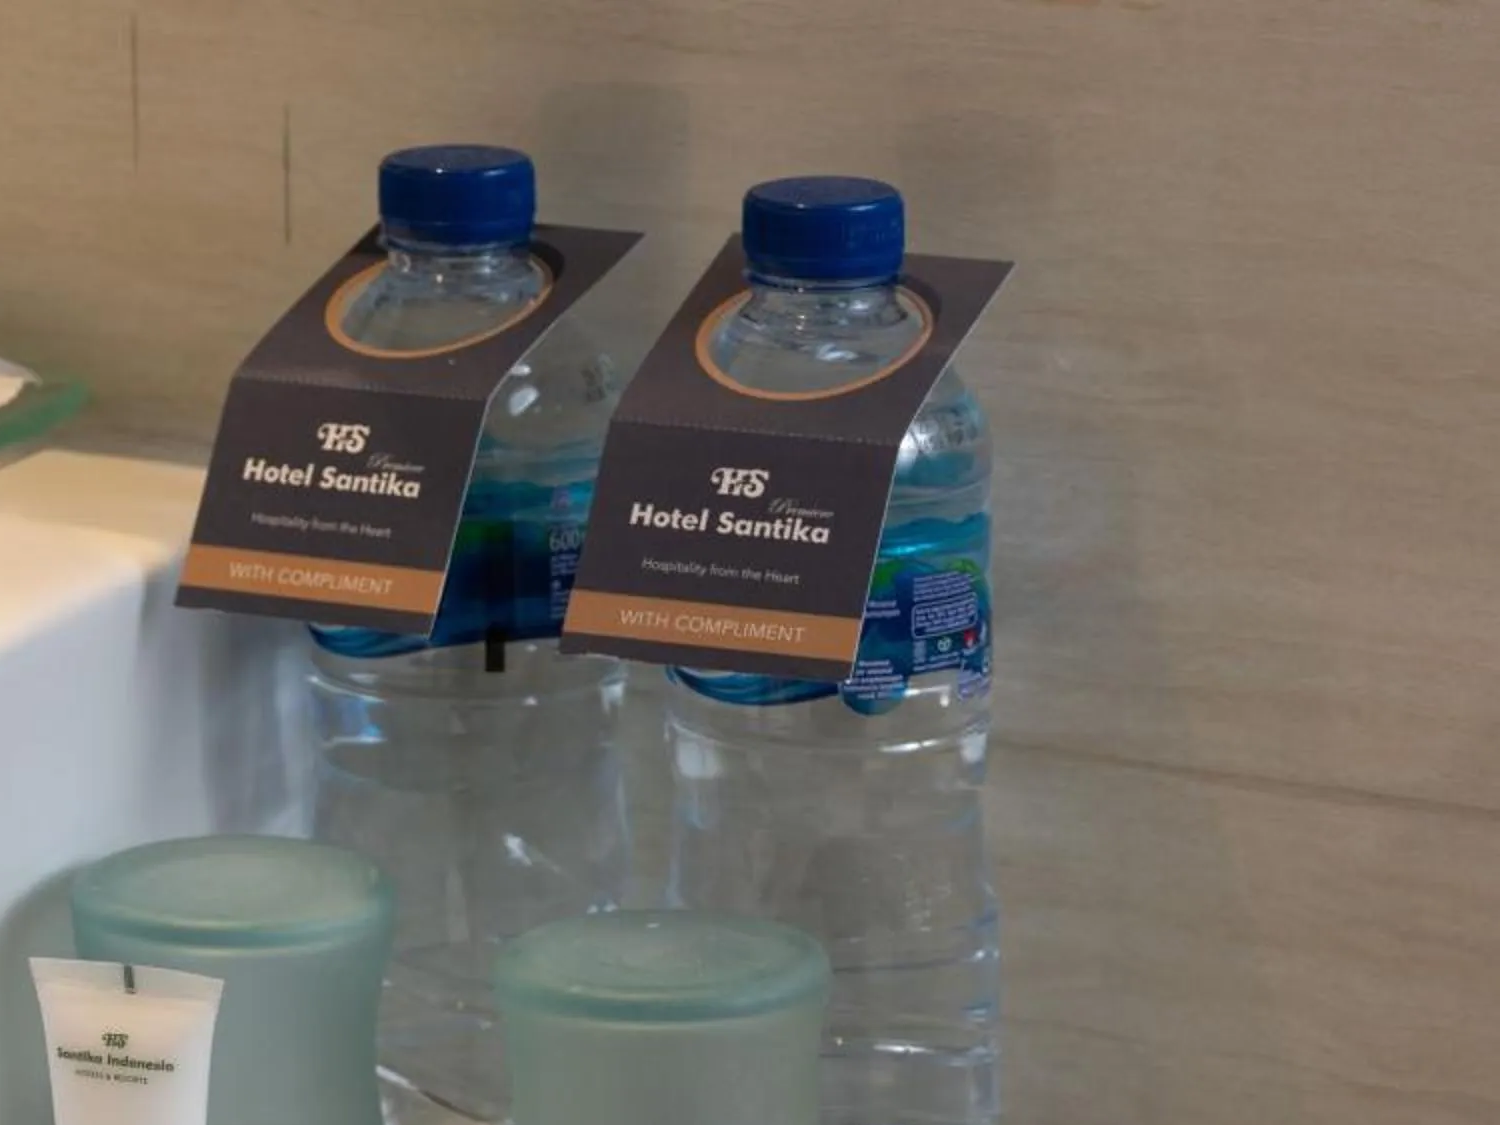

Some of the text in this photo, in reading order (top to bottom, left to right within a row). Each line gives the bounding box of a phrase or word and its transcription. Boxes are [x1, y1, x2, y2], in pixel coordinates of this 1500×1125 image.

[243, 457, 421, 499] Hotel Santika
[251, 511, 393, 540] Hospitality from the Heart
[628, 502, 831, 545] Hotel Santika
[227, 561, 394, 595] WITH COMPLIMENT
[641, 557, 801, 586] Hospitality from the Heart
[618, 609, 807, 643] WITH COMPLIMENT
[56, 1046, 176, 1073] Santika Indonesia
